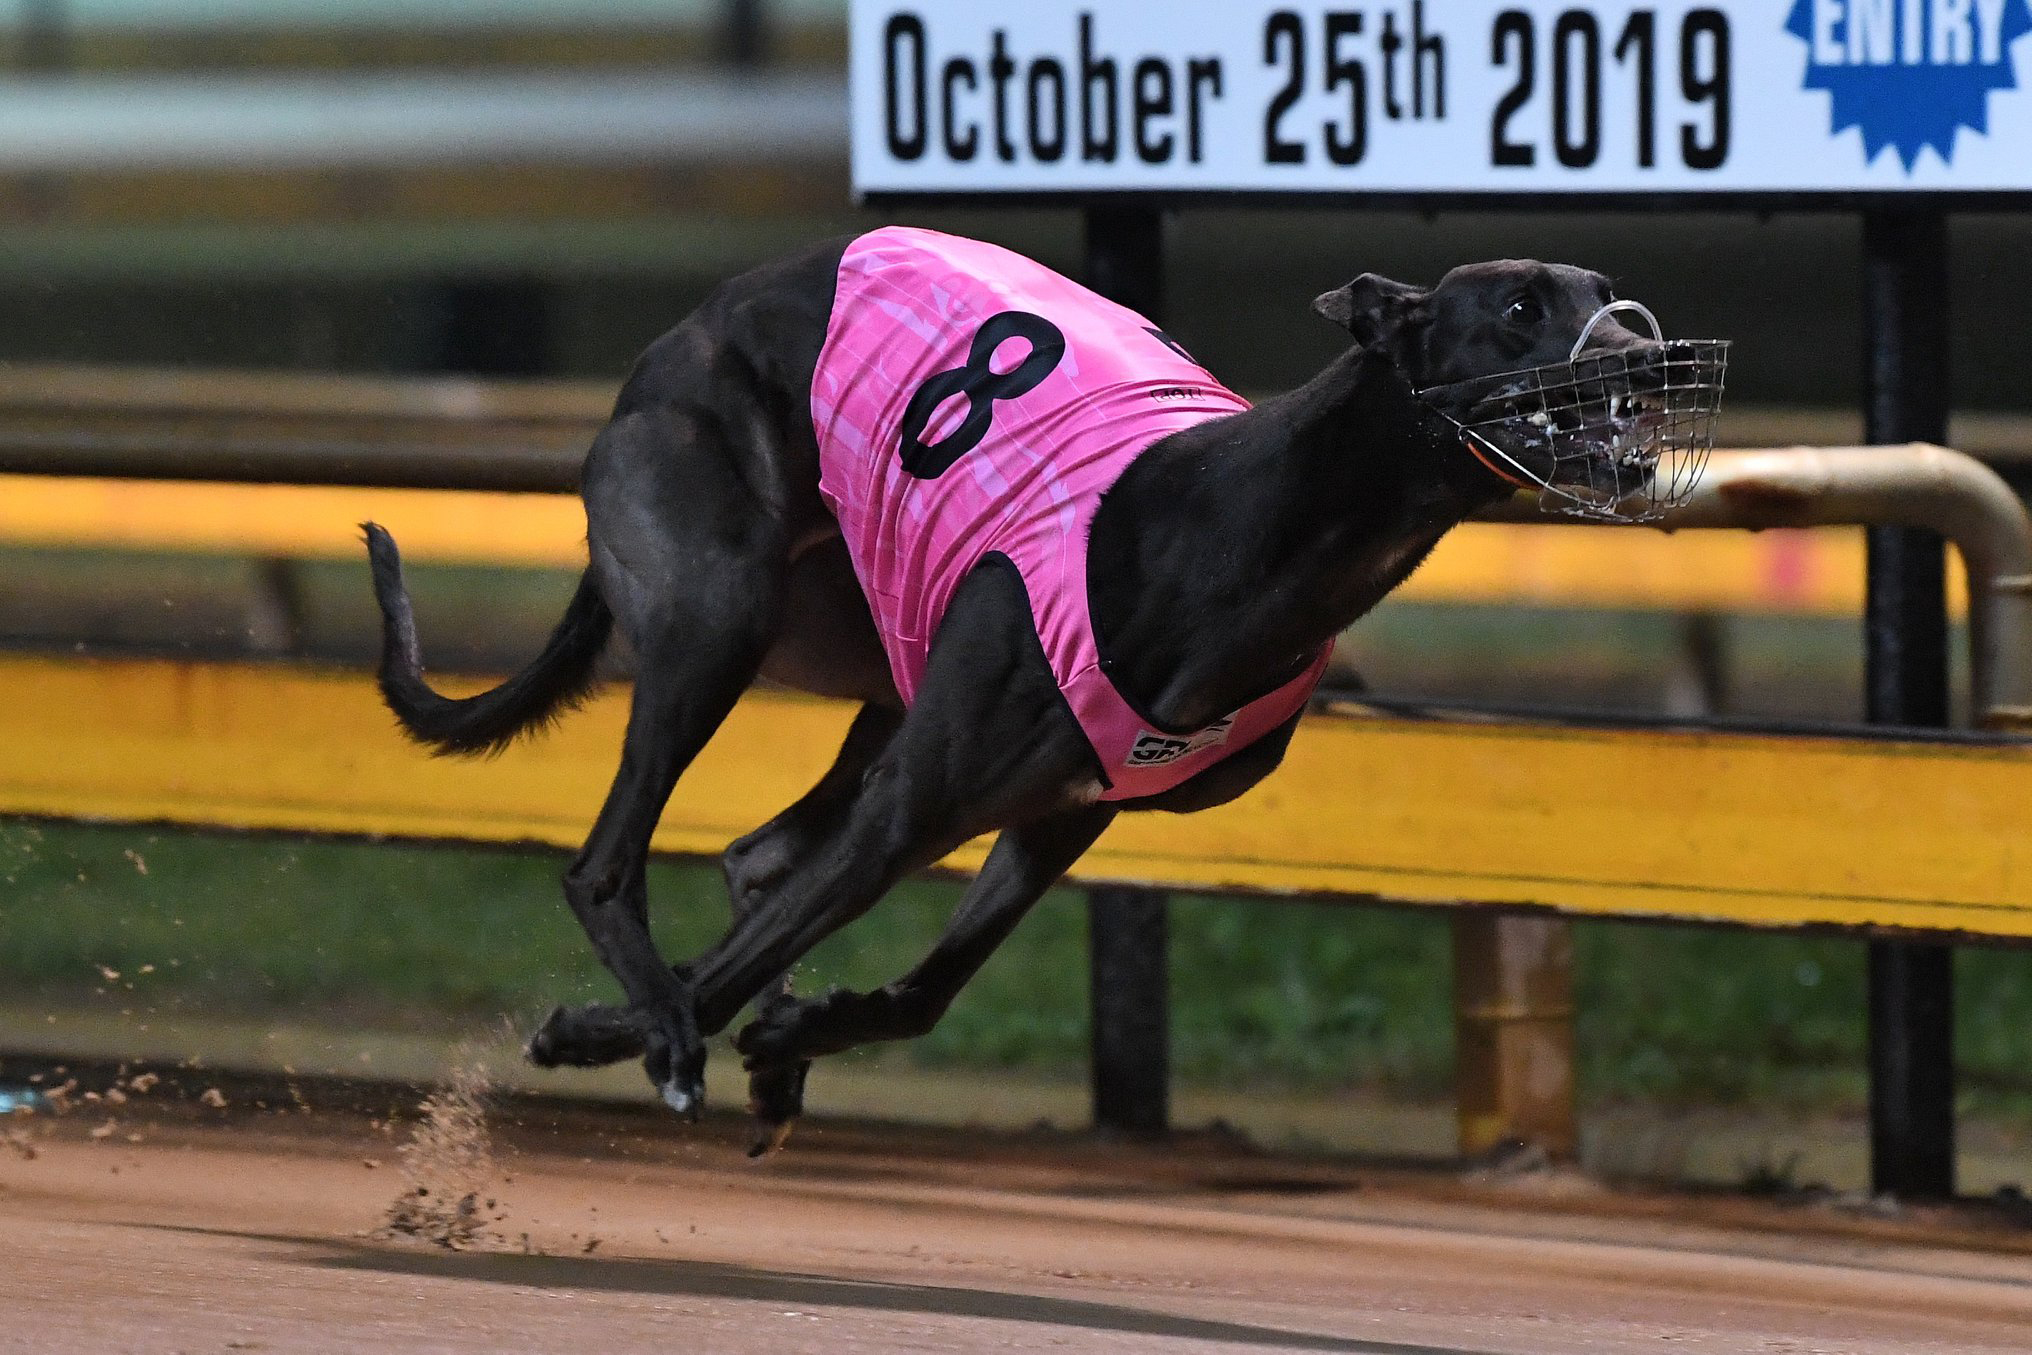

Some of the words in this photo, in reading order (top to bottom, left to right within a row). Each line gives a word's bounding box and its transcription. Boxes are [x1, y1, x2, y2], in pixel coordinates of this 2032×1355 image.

[884, 10, 1223, 164] October
[1262, 0, 1445, 166] 25th
[1491, 7, 1731, 170] 2019
[899, 311, 1065, 479] 8
